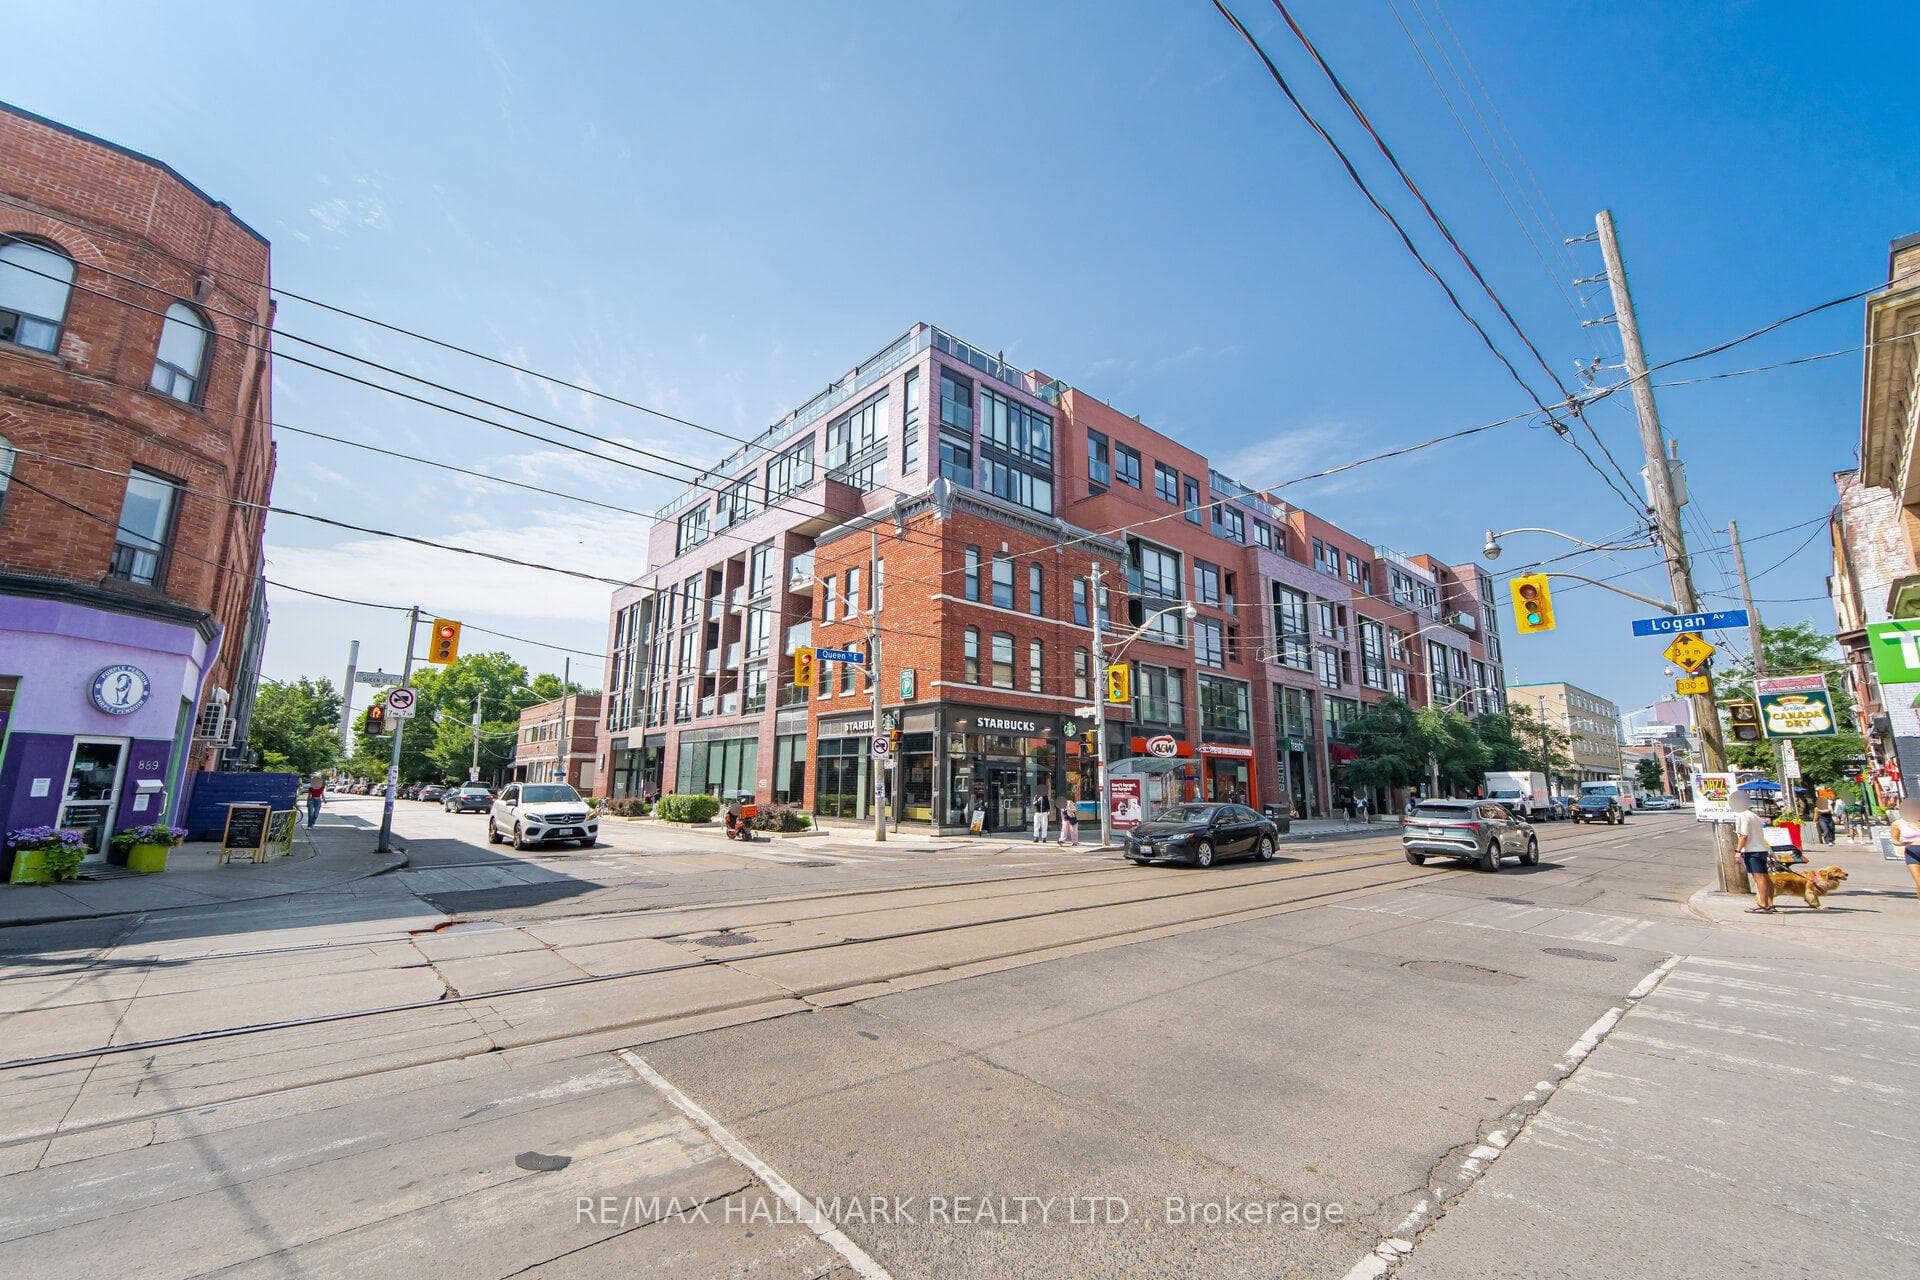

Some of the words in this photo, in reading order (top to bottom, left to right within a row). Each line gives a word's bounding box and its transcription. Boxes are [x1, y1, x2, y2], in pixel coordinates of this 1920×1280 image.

[1651, 617, 1706, 631] Logan
[1880, 629, 1920, 669] T
[822, 650, 846, 660] Queen
[853, 653, 858, 661] E
[1679, 682, 1697, 690] 300
[1772, 710, 1823, 720] CANADA
[844, 721, 874, 731] STARBU
[977, 717, 1035, 732] STARBUCKS
[1785, 719, 1811, 728] DRY
[1155, 743, 1175, 753] A&W
[138, 760, 159, 771] 889
[1703, 780, 1726, 790] JAZZ
